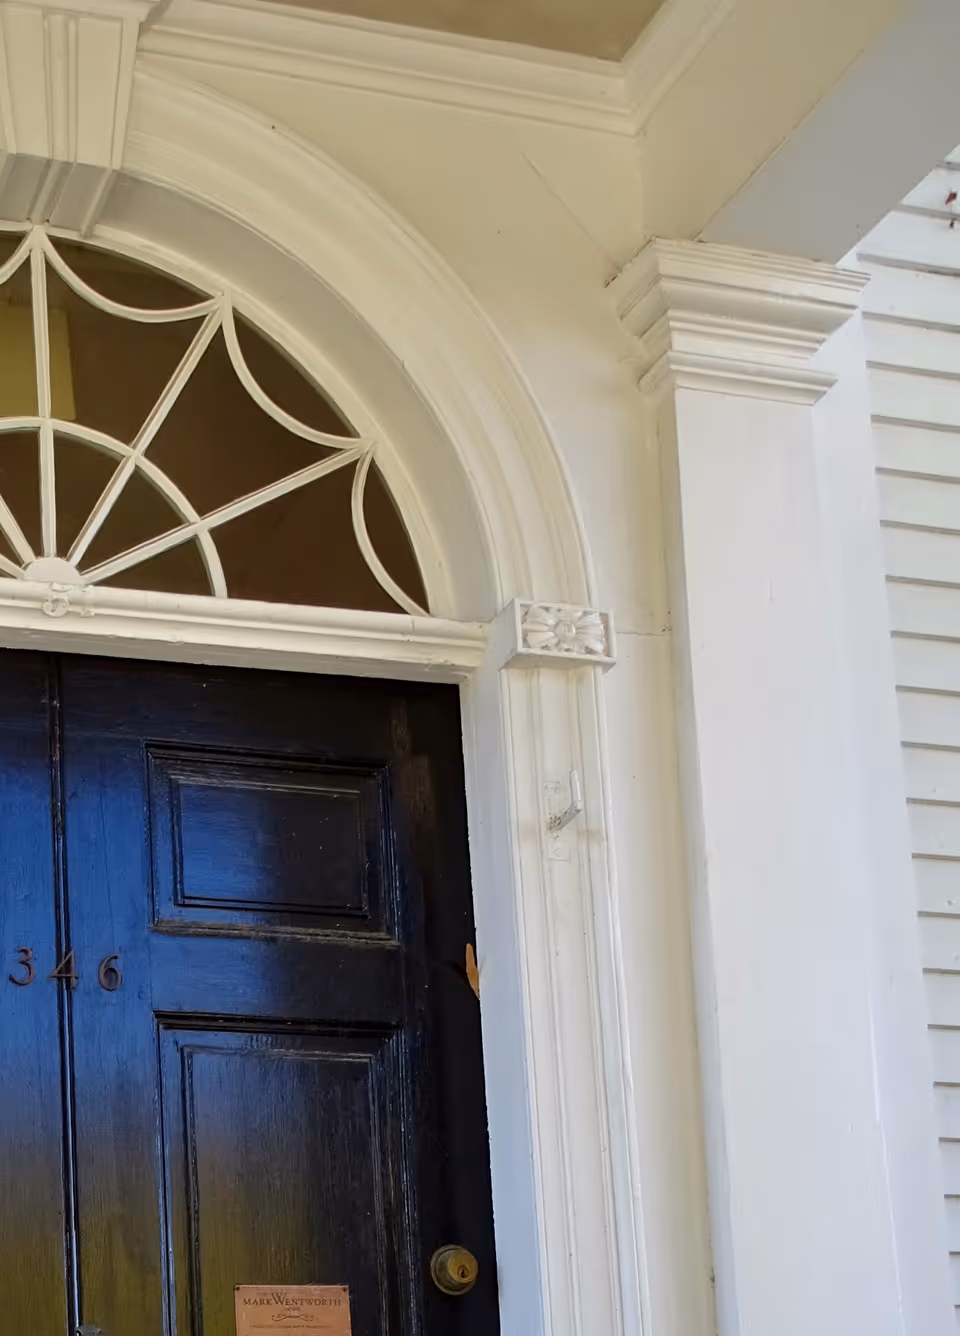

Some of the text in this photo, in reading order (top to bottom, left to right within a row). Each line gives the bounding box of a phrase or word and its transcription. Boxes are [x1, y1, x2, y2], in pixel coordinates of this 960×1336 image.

[8, 946, 122, 992] 346
[242, 1292, 342, 1307] MARK WENTWORTH
